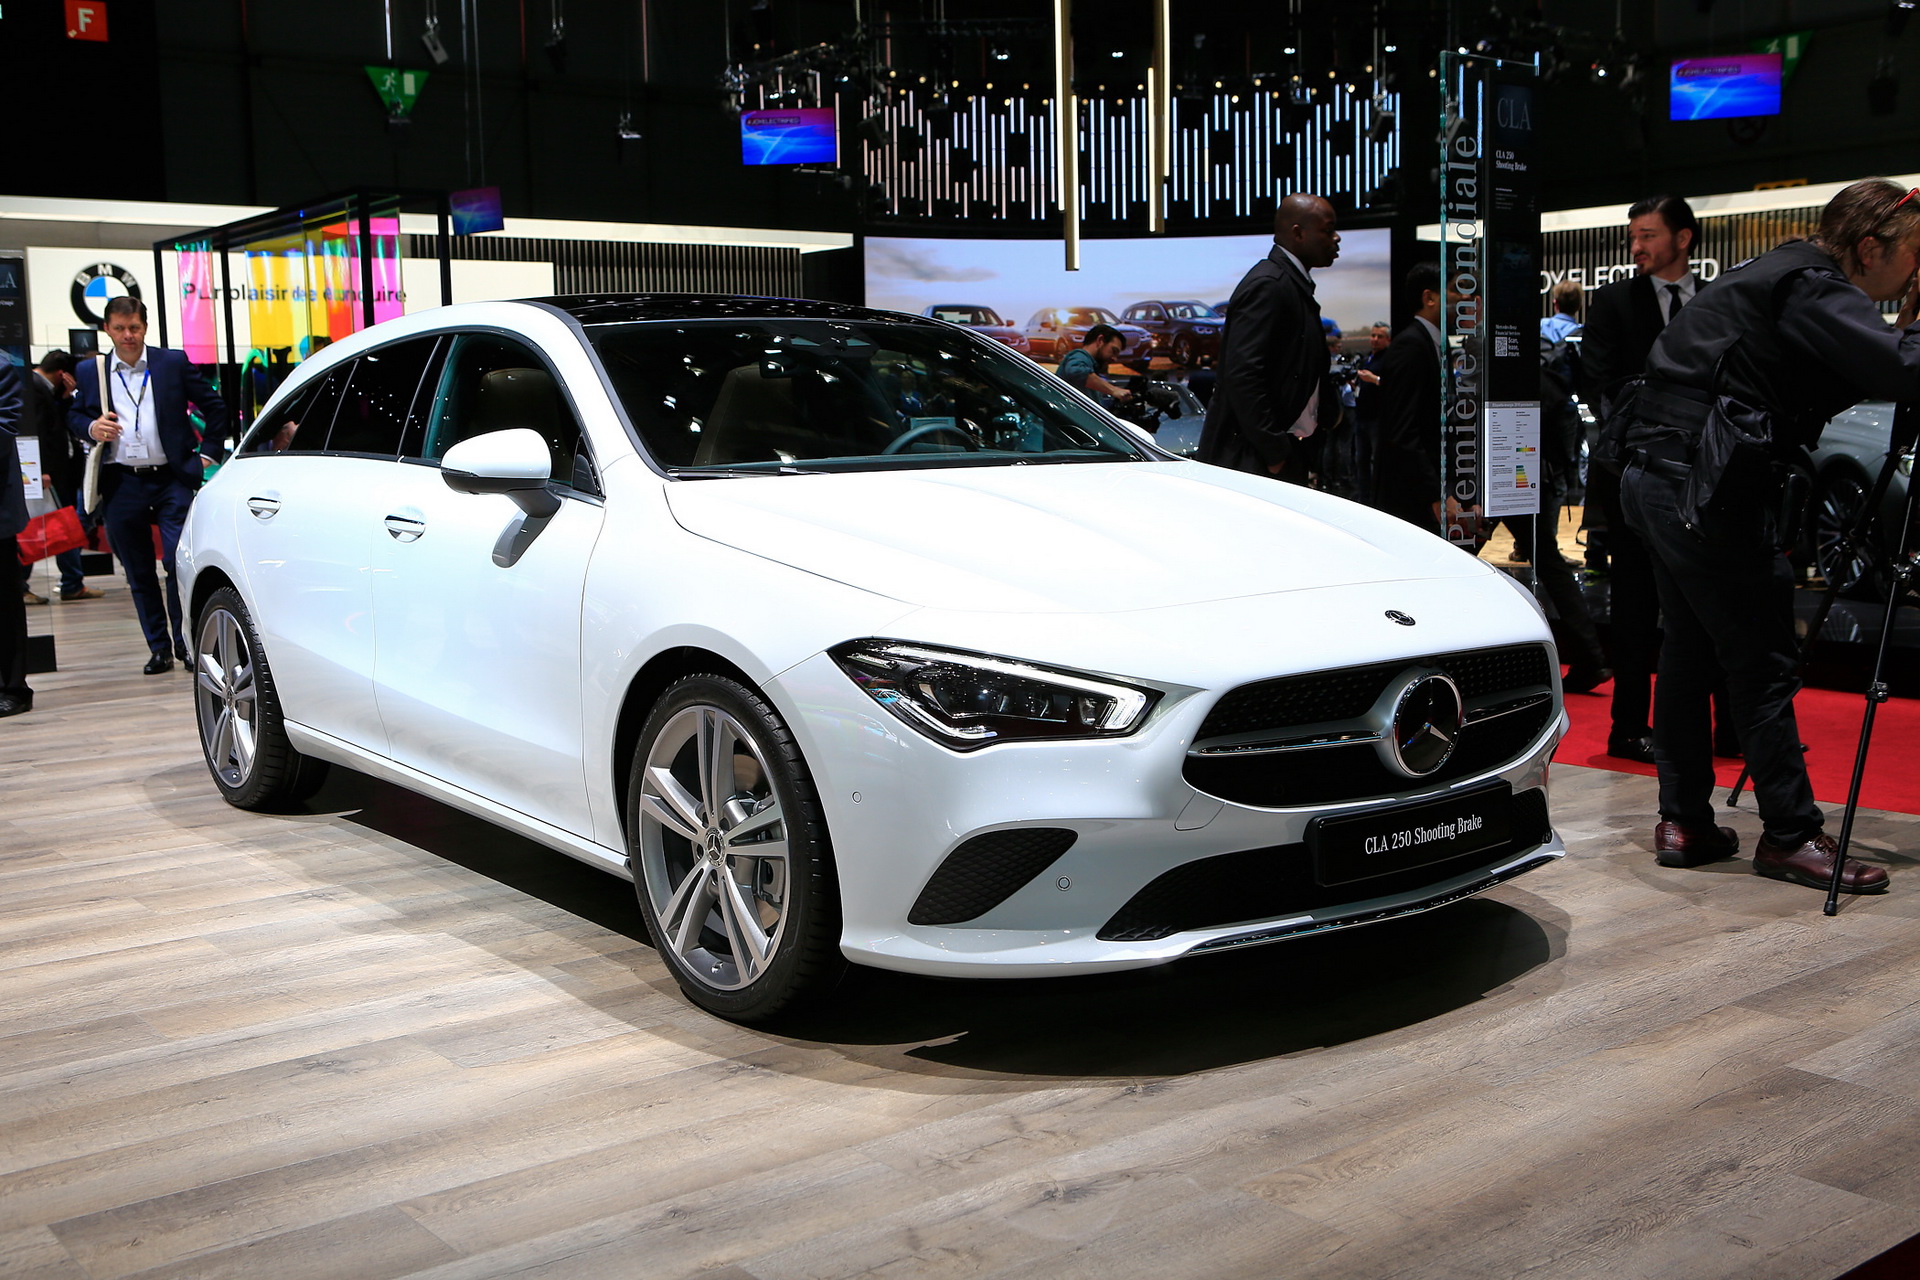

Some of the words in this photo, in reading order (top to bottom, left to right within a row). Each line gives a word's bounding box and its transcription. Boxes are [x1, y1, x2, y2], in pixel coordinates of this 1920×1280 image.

[78, 8, 94, 32] F
[1497, 98, 1532, 131] CLA
[1448, 136, 1476, 338] mondiale
[75, 263, 138, 287] BMW
[1448, 354, 1476, 548] Première
[1365, 835, 1389, 855] CLA
[1392, 830, 1412, 849] 250
[1414, 822, 1456, 845] Shooting
[1457, 814, 1482, 834] Brake
